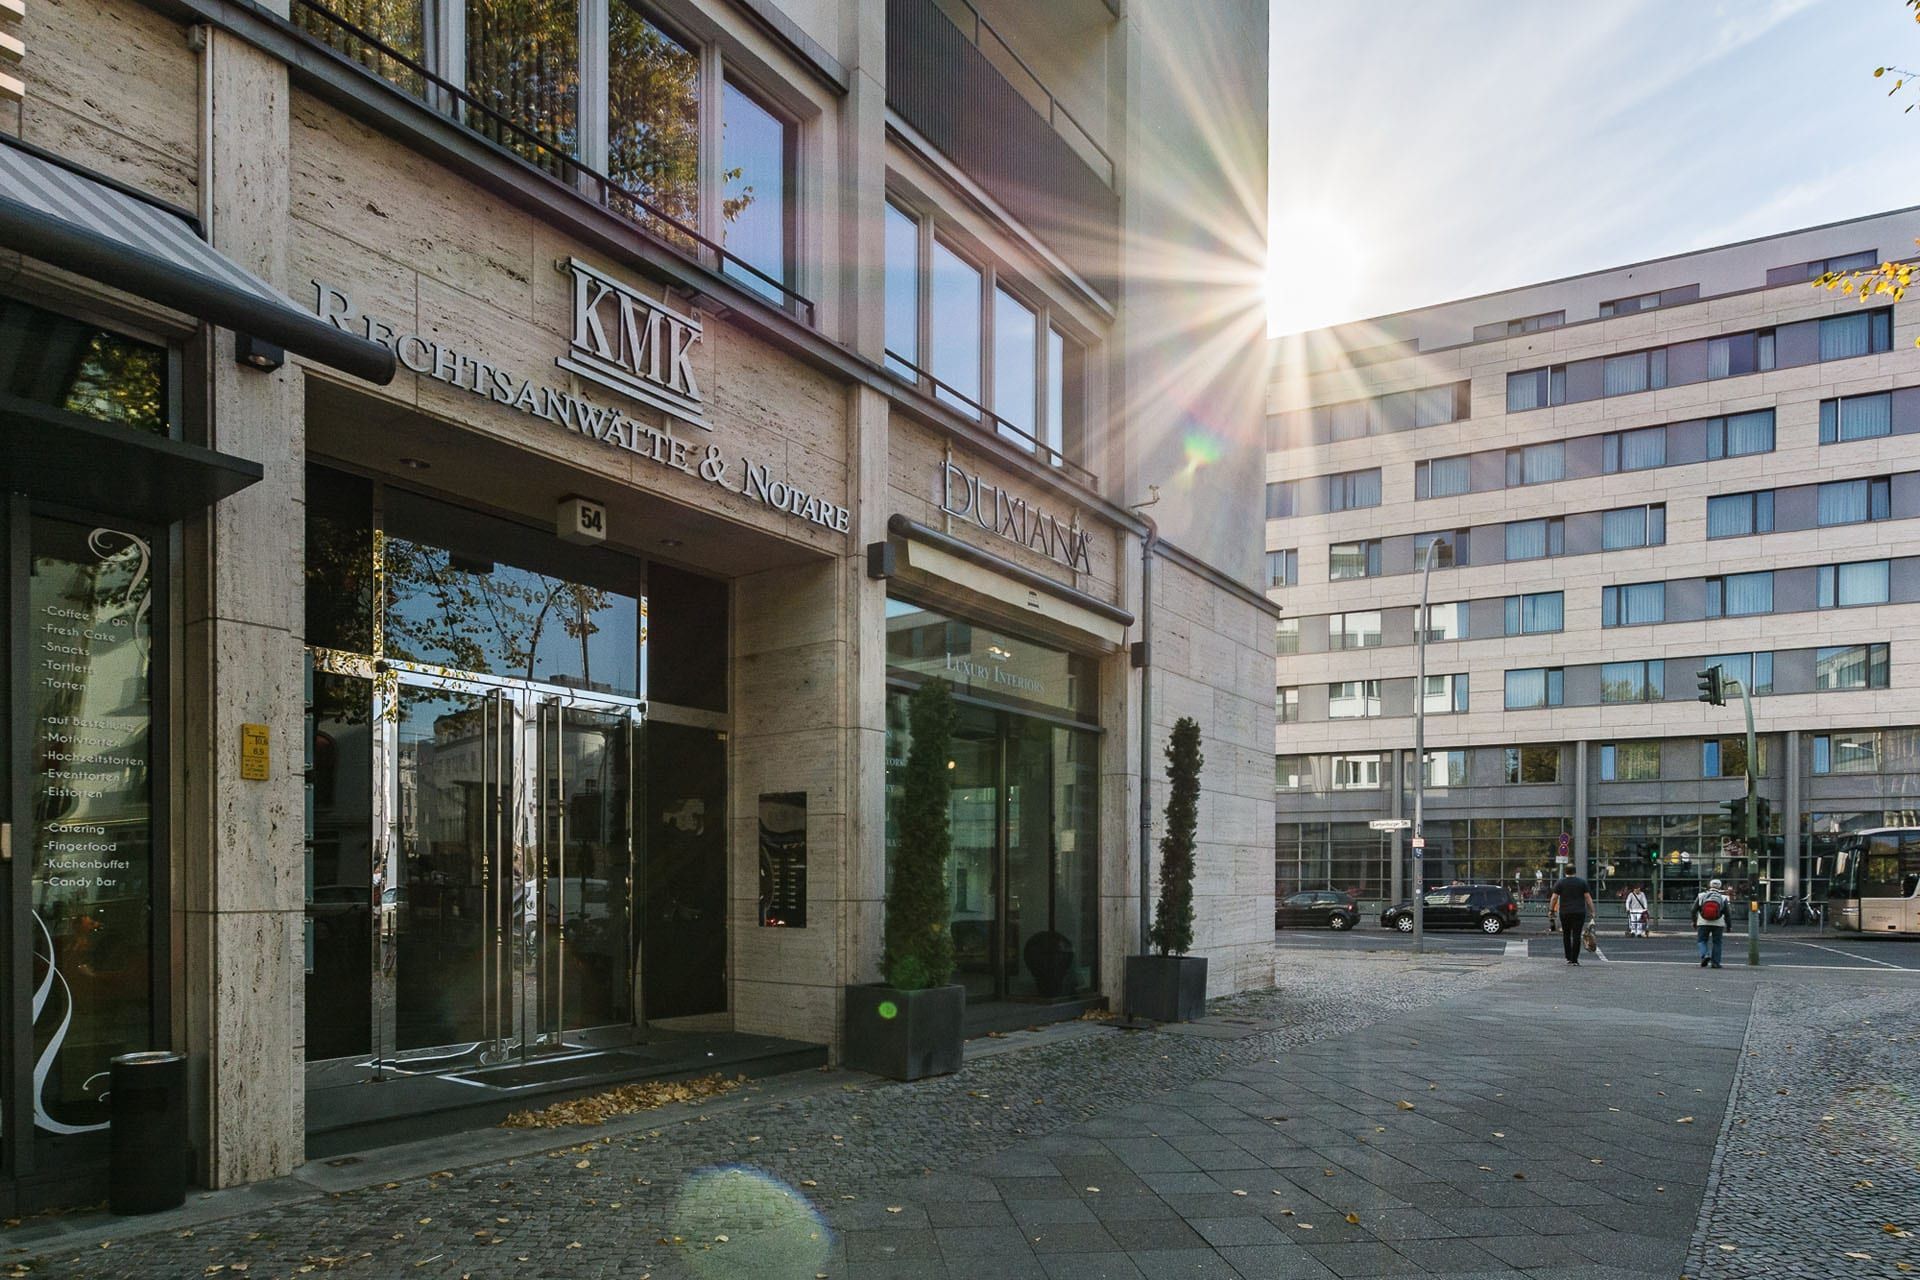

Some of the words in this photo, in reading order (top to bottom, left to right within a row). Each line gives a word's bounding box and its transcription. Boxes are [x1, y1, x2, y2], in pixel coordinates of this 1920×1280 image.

[570, 266, 703, 404] KMK
[699, 443, 740, 490] &
[742, 457, 850, 534] NOTARE
[581, 505, 603, 533] 54
[83, 629, 116, 642] Cake
[111, 617, 129, 627] go
